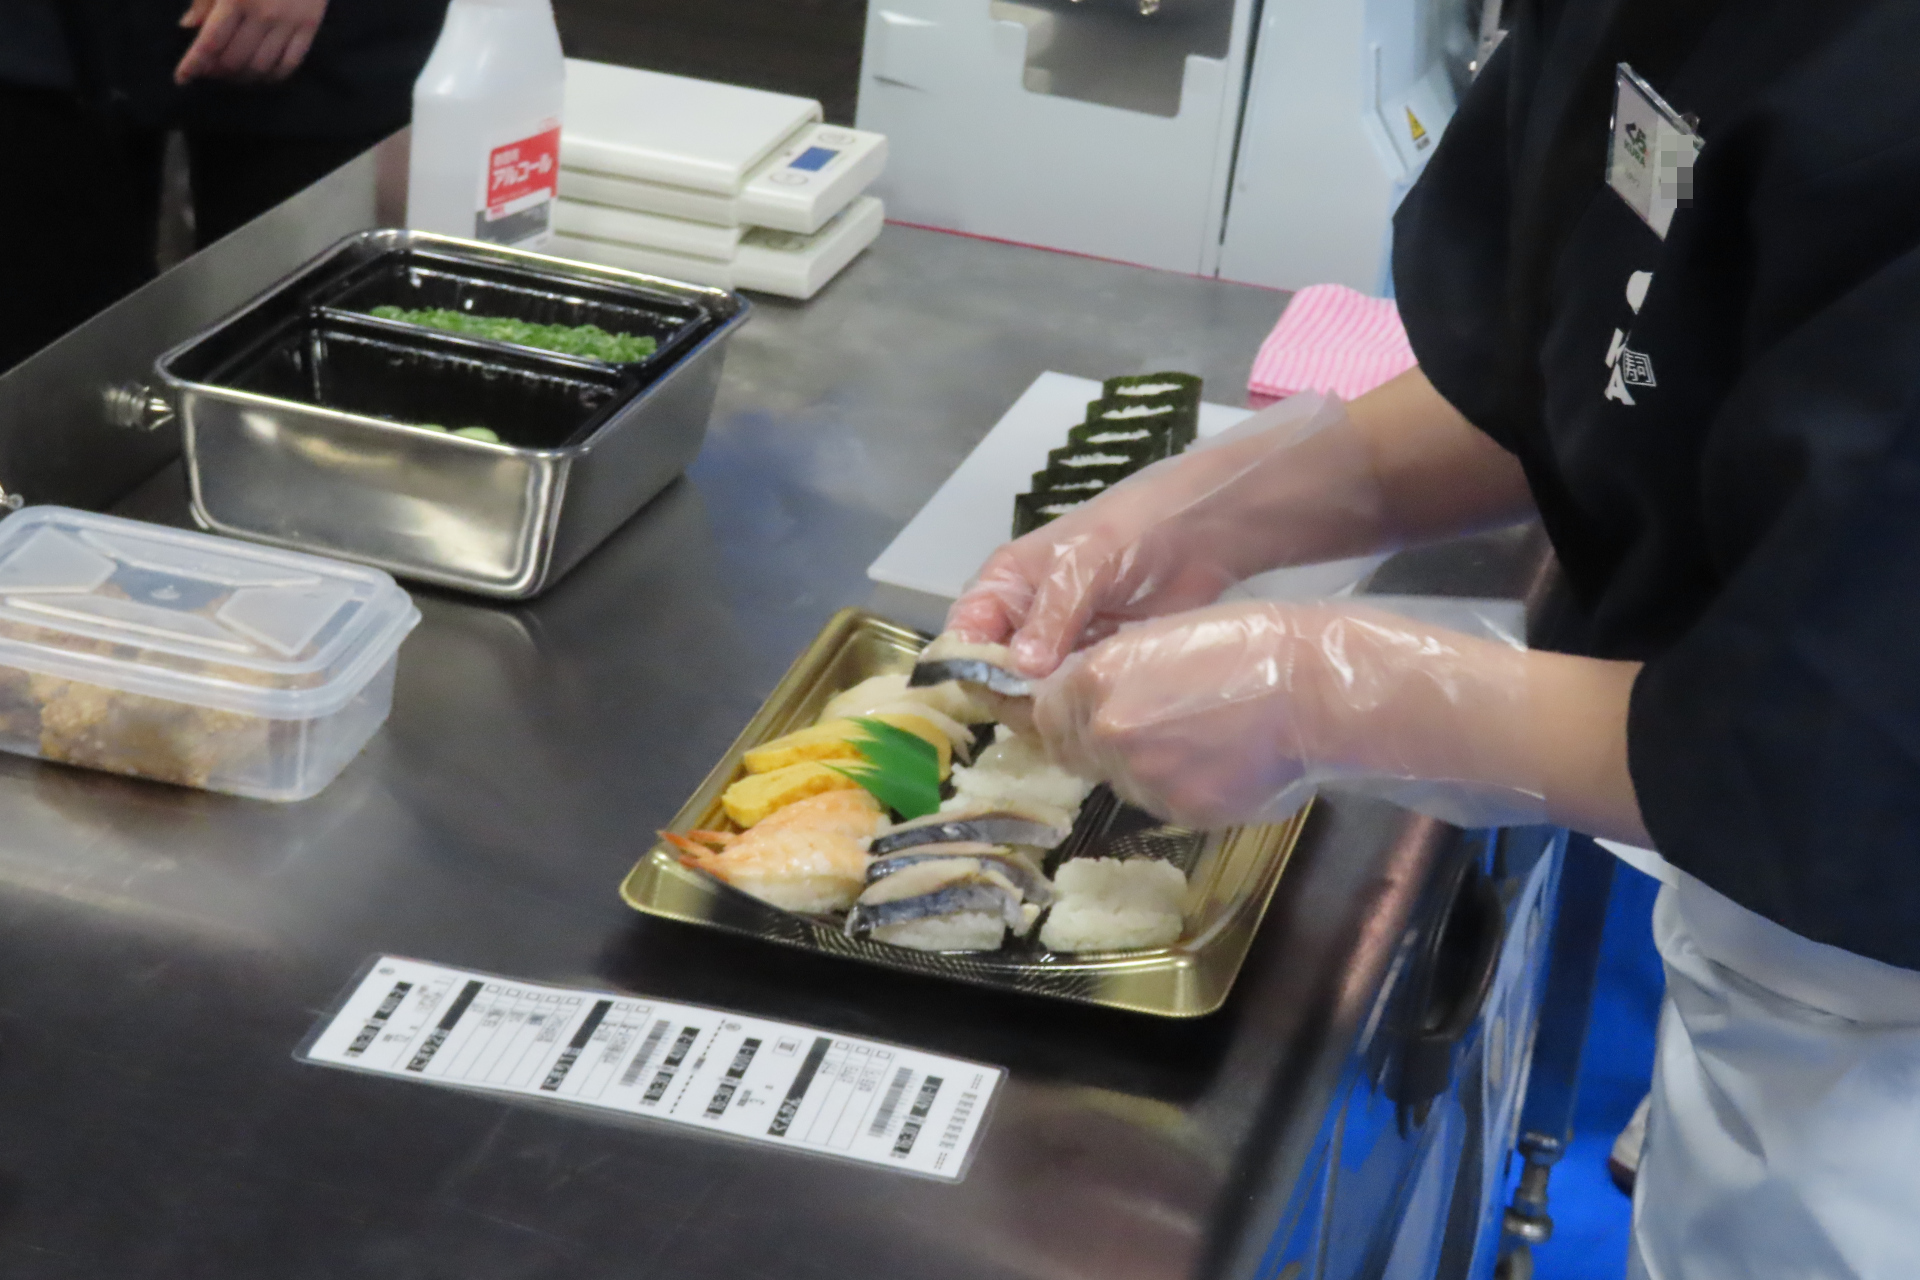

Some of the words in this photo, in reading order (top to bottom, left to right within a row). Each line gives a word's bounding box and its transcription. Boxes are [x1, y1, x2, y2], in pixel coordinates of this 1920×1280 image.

[493, 153, 552, 190] アルコール
